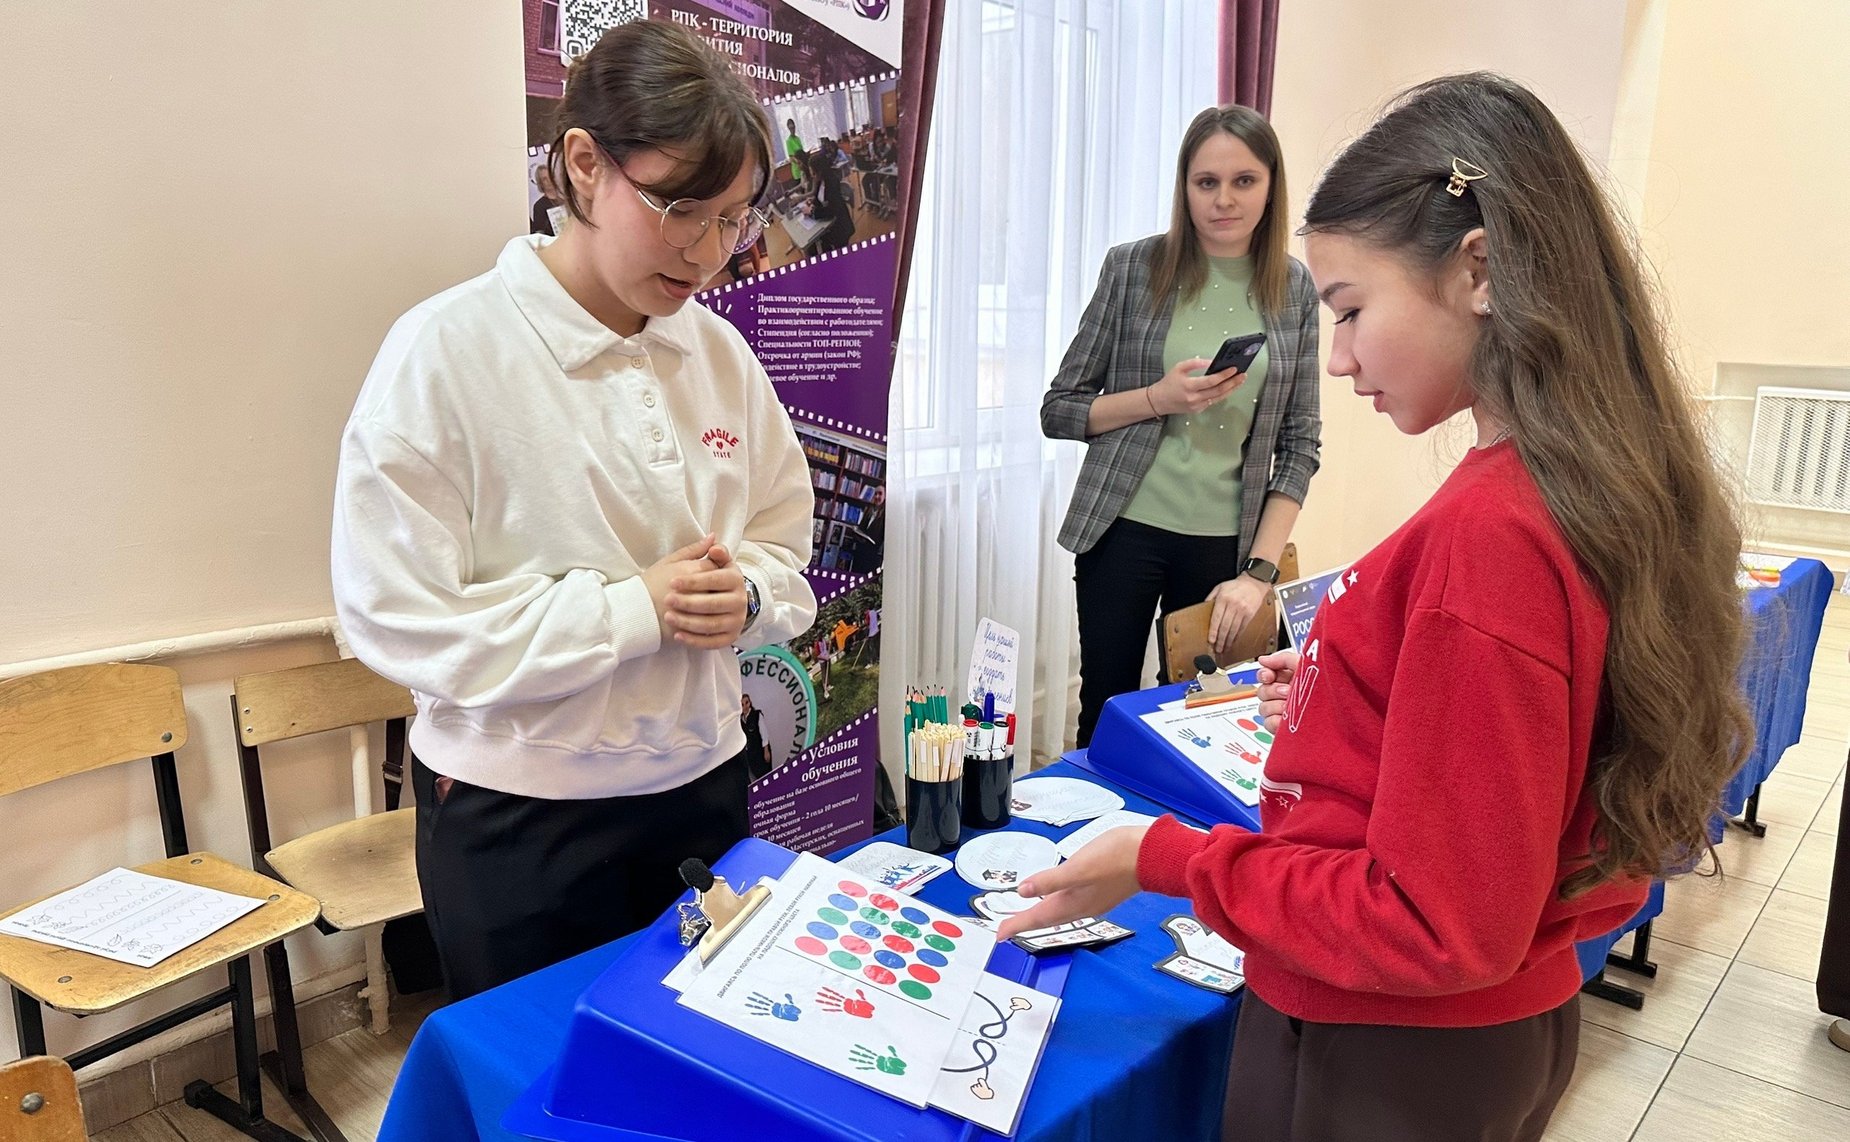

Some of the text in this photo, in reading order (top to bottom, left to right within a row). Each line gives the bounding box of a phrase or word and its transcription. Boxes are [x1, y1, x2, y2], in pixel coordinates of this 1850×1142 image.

[671, 9, 699, 28] РПК
[709, 17, 793, 46] ТЕРРИТОРИЯ
[697, 35, 743, 55] ИТИЯ
[728, 60, 801, 85] СИОНАЛОВ
[757, 293, 787, 303] Диплом
[788, 295, 847, 305] государственного
[853, 306, 883, 317] обучение
[768, 318, 824, 326] взаимодействии
[757, 328, 797, 337] Стипендия
[798, 329, 830, 338] (согласно
[757, 339, 862, 349] Специальности ТОП-РЕГИОН;
[757, 351, 791, 361] Отсрочка
[801, 353, 823, 361] армии
[824, 351, 846, 360] (закон
[761, 363, 798, 371] одействие
[788, 374, 819, 383] обучение
[701, 428, 739, 447] FRAGILE
[740, 659, 807, 755] ФЕССИОНАЛ
[808, 737, 859, 764] Условия
[801, 755, 859, 782] обучения
[753, 767, 862, 810] обучение на базе основного общего
[753, 800, 795, 820] образования
[753, 809, 797, 829] очная форма
[753, 828, 769, 839] срок
[769, 816, 801, 832] обучения
[810, 808, 824, 818] года
[775, 826, 801, 840] месяцев
[827, 819, 865, 837] оснащенных
[786, 822, 834, 847] рабочая неделя
